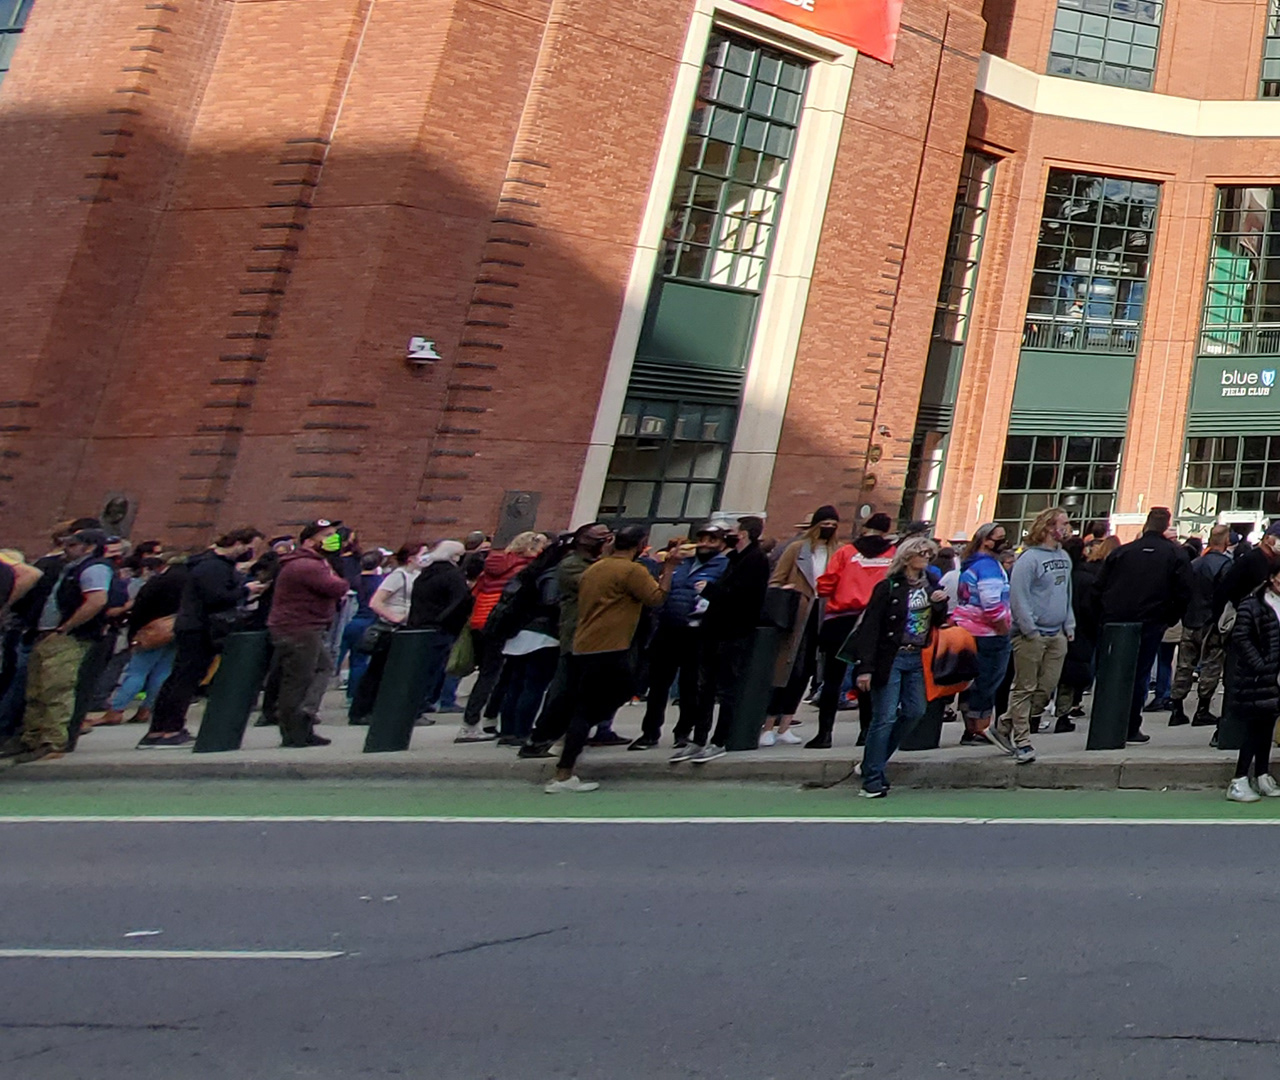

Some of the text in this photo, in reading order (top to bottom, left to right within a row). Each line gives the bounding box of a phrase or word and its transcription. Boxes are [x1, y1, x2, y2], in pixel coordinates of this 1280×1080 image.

[1221, 369, 1258, 385] blue
[1222, 387, 1270, 396] FIELD CLUB
